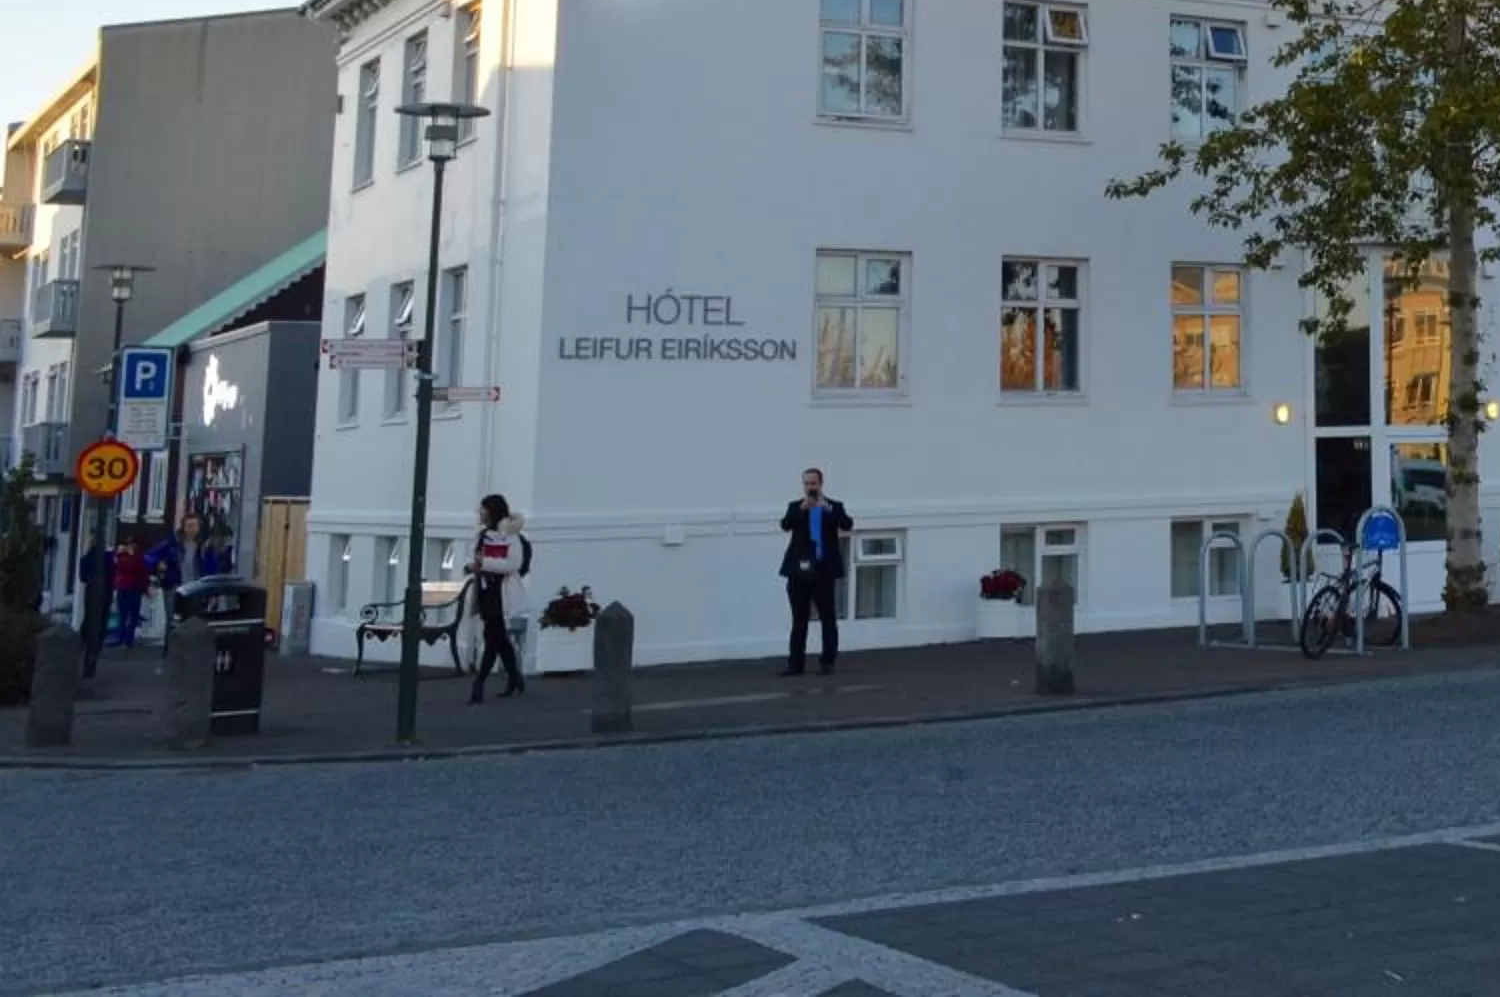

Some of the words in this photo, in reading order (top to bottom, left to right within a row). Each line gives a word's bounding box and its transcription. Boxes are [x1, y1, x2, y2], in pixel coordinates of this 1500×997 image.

[625, 288, 746, 325] HÓTEL
[559, 336, 652, 360] LEIFUR
[661, 333, 797, 361] EIRÍKSSON
[135, 360, 157, 391] P
[87, 457, 129, 480] 30
